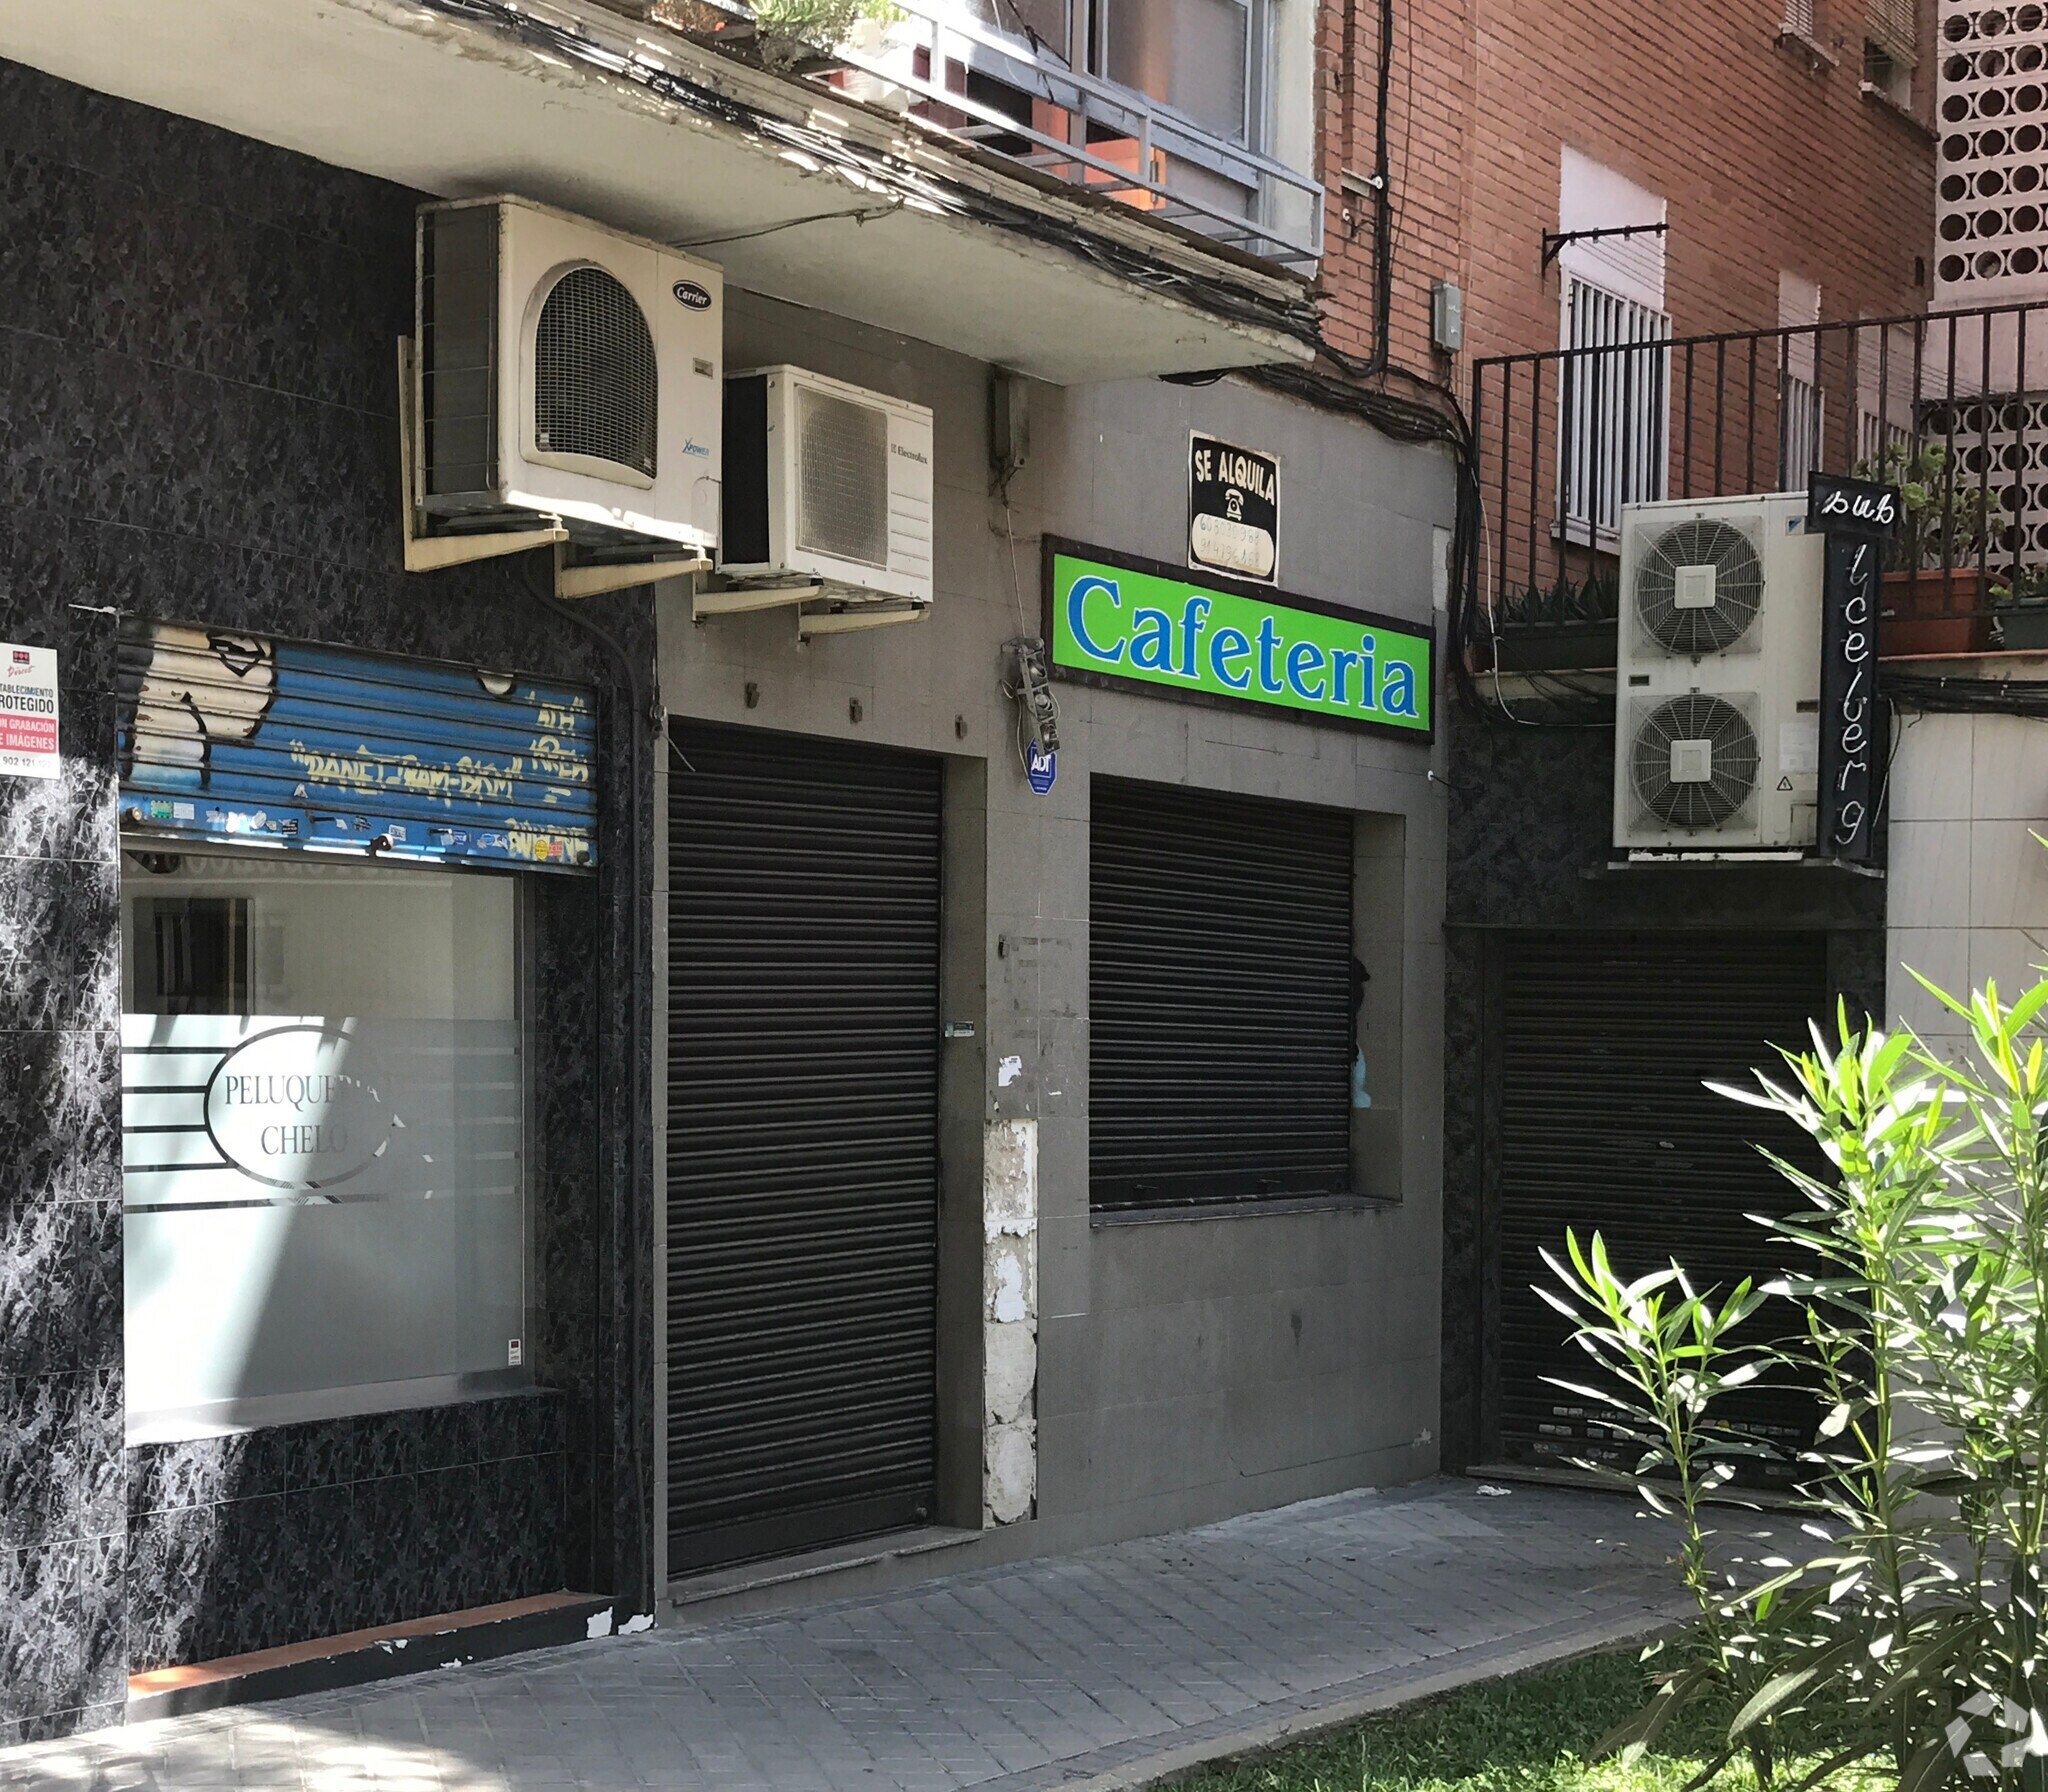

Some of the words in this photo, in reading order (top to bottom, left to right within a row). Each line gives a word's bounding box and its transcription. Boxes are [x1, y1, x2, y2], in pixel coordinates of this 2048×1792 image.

[676, 286, 708, 305] Carrier
[1194, 449, 1212, 483] SE
[1218, 451, 1276, 506] ALQUILA
[1067, 574, 1421, 719] Cafeteria
[7, 664, 36, 678] Direct
[9, 718, 55, 734] GRABACIÓN
[6, 731, 55, 750] IMÁGENES
[3, 756, 19, 767] 902
[1031, 753, 1052, 773] ADT
[261, 1125, 348, 1155] CHELO
